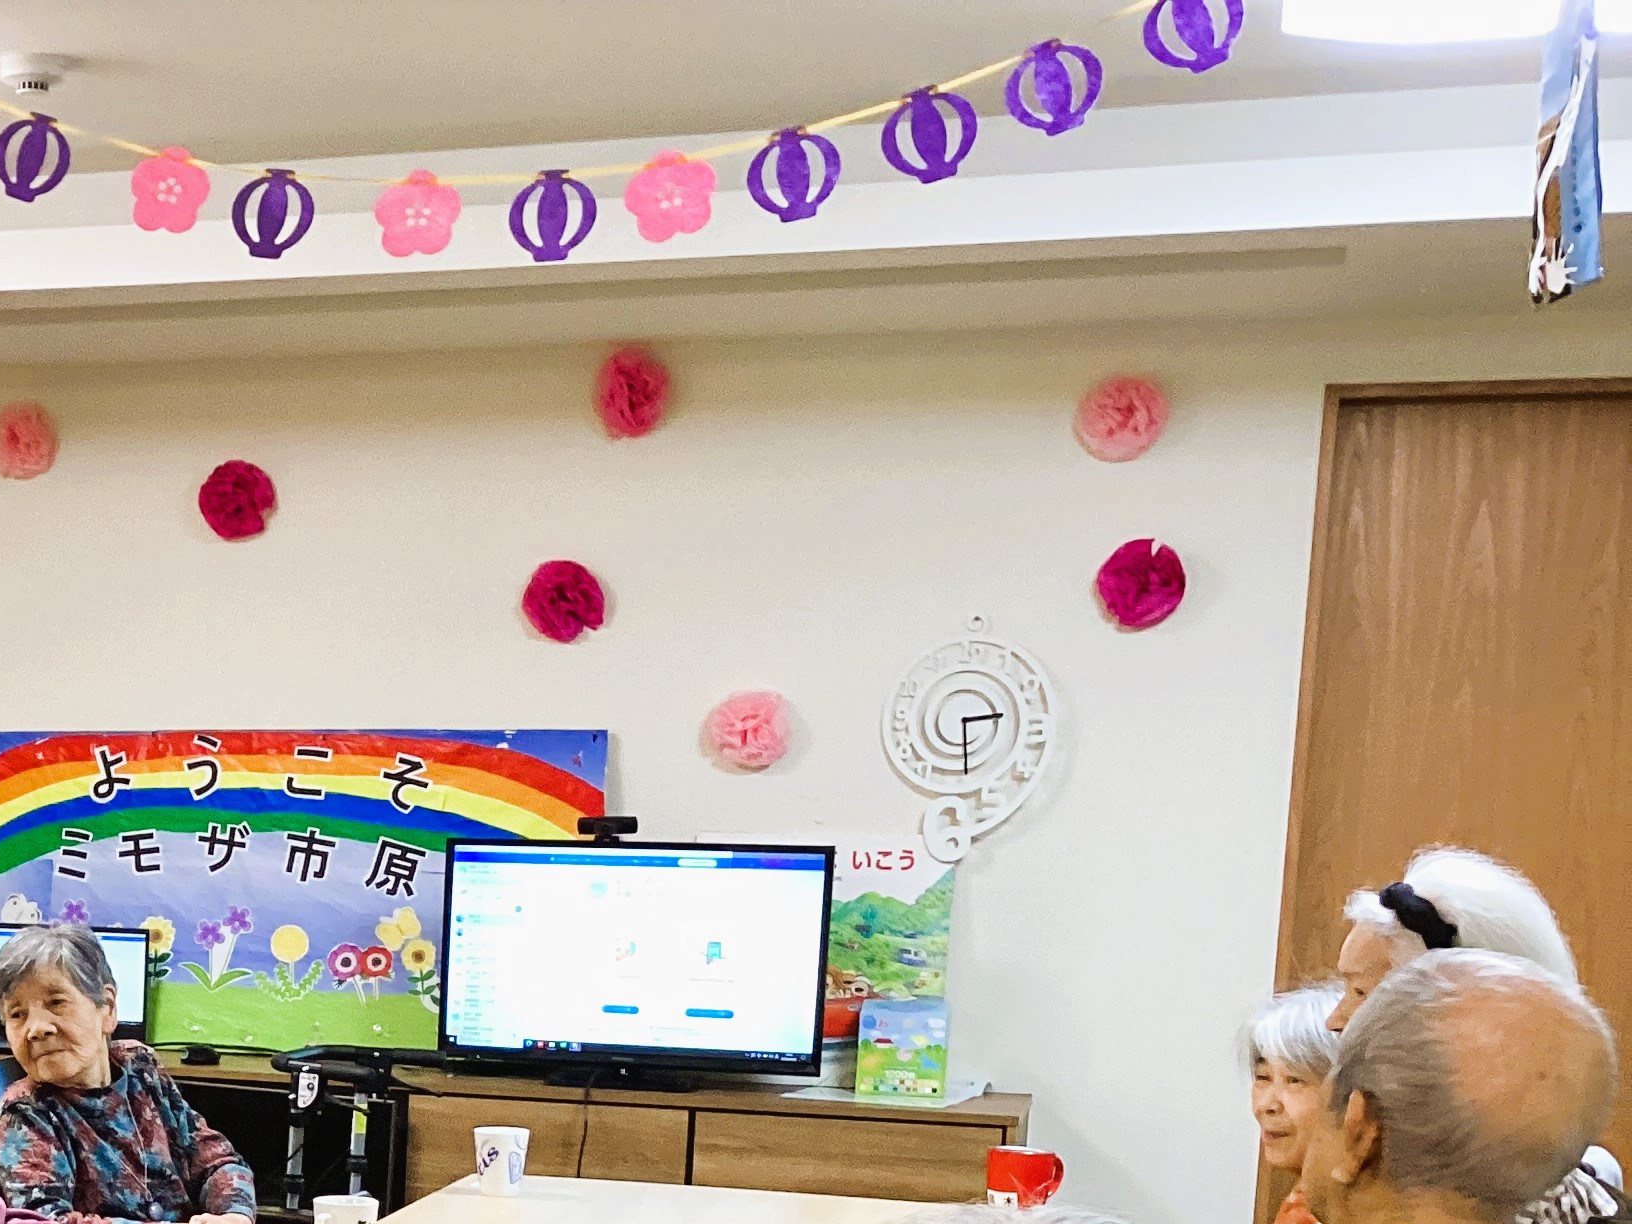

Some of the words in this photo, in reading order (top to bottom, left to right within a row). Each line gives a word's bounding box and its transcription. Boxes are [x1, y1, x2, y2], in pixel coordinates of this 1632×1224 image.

[91, 734, 430, 811] ようこそ
[57, 822, 427, 898] ミモザ市原
[852, 849, 915, 871] いこう
